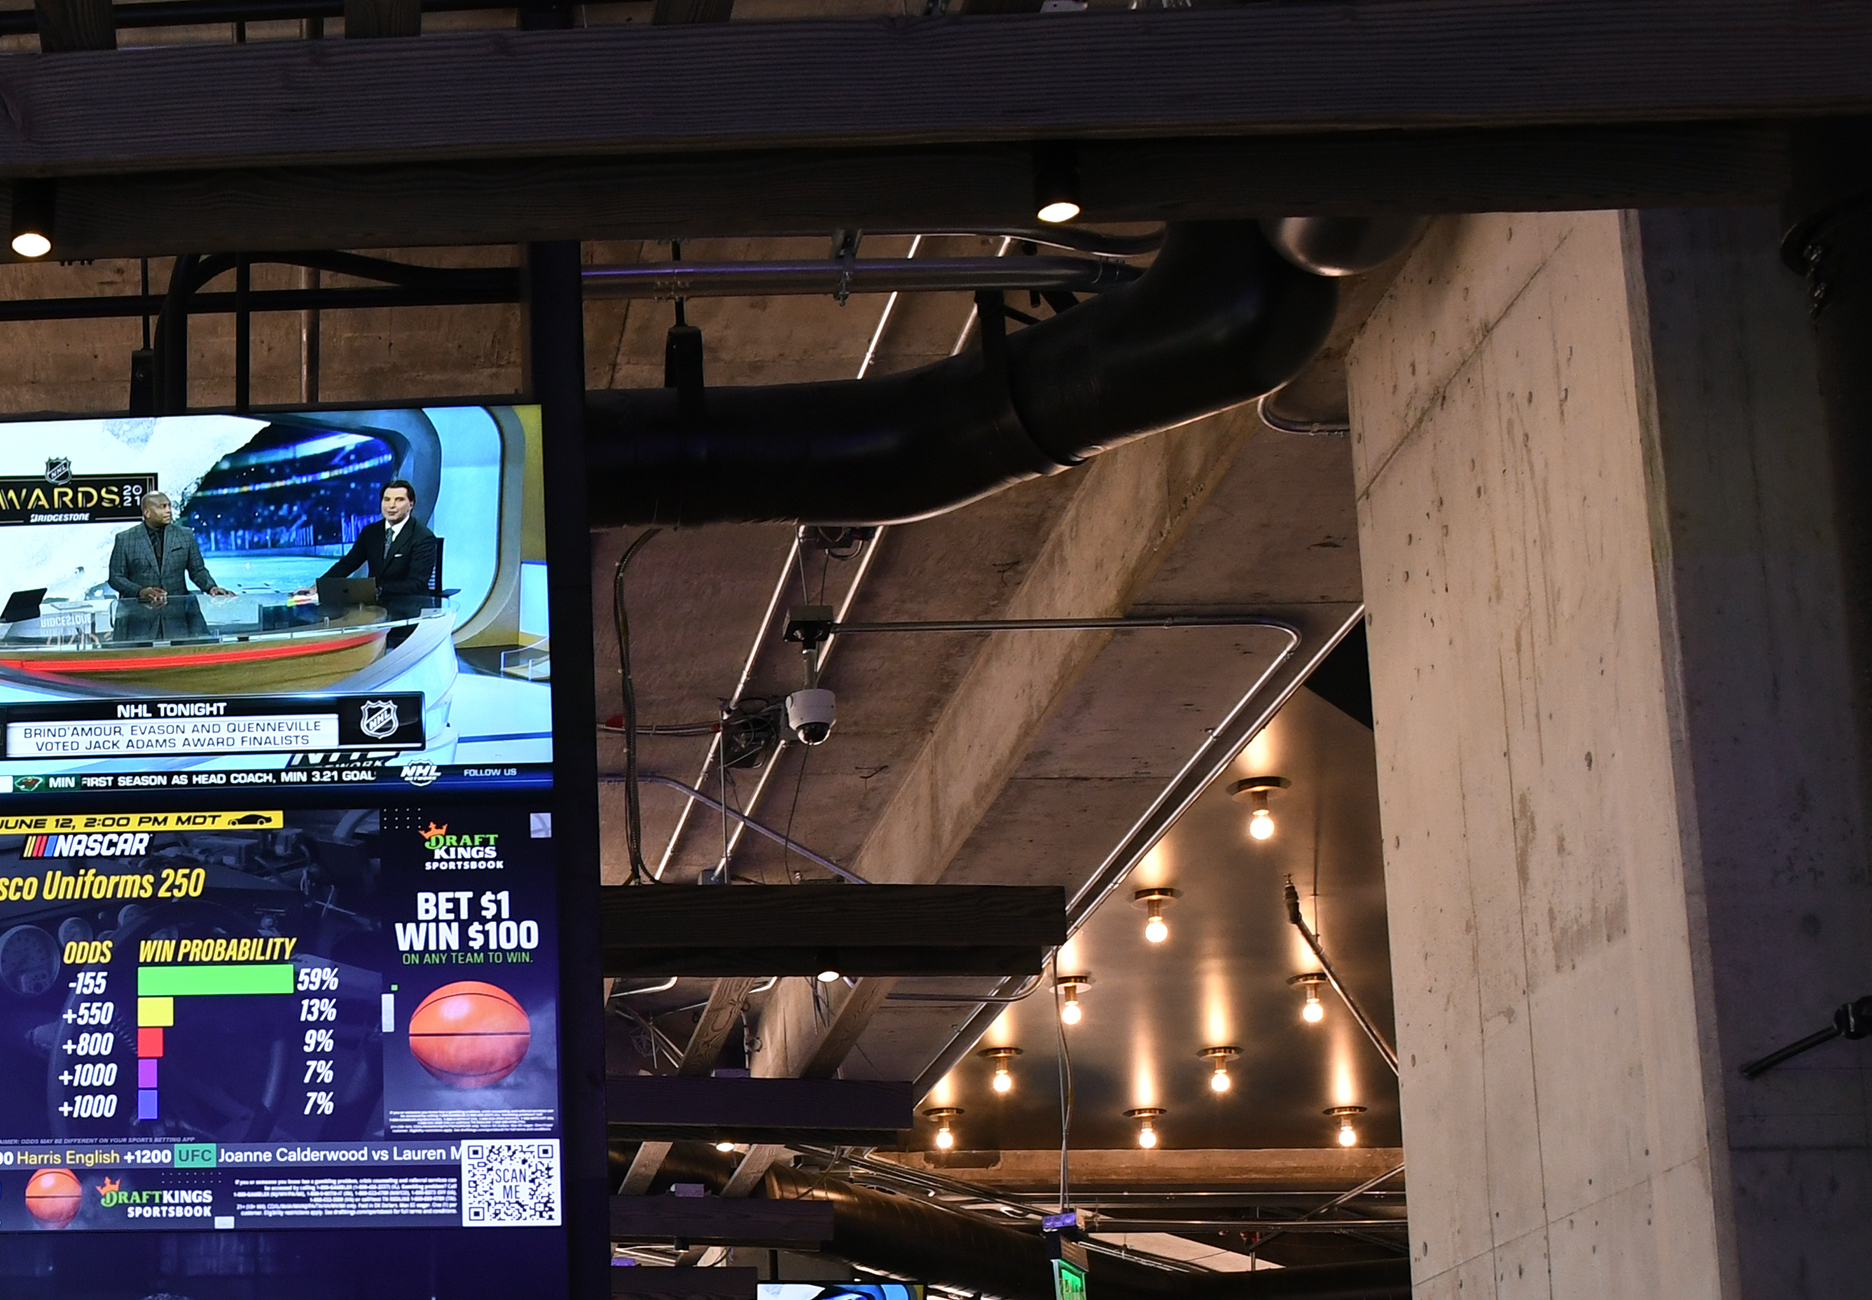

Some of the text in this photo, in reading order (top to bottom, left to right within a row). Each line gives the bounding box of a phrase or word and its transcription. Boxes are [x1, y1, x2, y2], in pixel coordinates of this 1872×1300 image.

[117, 702, 227, 717] NHL TONIGHT
[130, 723, 188, 737] EVASON
[191, 722, 221, 734] AND
[226, 720, 321, 733] QUENNEVILLE
[36, 734, 310, 752] VOTED JACK ADAMS AWARD FINALISTS
[49, 776, 76, 789] MIN
[117, 770, 339, 787] SEASON AS HEAD COACH, MIN 3.21
[54, 817, 76, 832] 12,
[84, 816, 131, 828] 2:00
[137, 816, 170, 828] PM
[175, 814, 222, 827] MDT
[53, 833, 150, 858] NASCAR
[424, 834, 499, 850] DRAFT
[434, 846, 497, 860] KINGS
[425, 861, 504, 870] SPORTSBOOK
[42, 868, 154, 900] Uniforms
[157, 868, 206, 898] 250
[417, 890, 510, 920] BET $1
[394, 920, 539, 951] WIN $100
[63, 941, 113, 964] ODDS
[139, 939, 176, 963] WIN
[177, 937, 297, 962] PROBABILITY
[402, 951, 533, 965] ON ANY TEAM TO WIN.
[68, 971, 107, 994] -155
[297, 967, 339, 991] 59%
[62, 1002, 114, 1025] +550
[300, 998, 337, 1022] 13%
[62, 1033, 114, 1056] +800
[303, 1029, 334, 1052] 9%
[58, 1063, 118, 1087] +1000
[303, 1060, 334, 1083] 7%
[58, 1094, 118, 1118] +1000
[303, 1091, 334, 1115] 7%
[17, 1150, 62, 1166] Harris
[66, 1149, 120, 1167] English
[123, 1149, 171, 1164] +1200
[178, 1149, 212, 1163] UFC
[218, 1148, 272, 1163] Joanne
[276, 1146, 367, 1162] Calderwood
[372, 1149, 389, 1161] vs
[393, 1146, 446, 1161] Lauren
[495, 1168, 527, 1183] SCAN
[502, 1185, 520, 1200] ME
